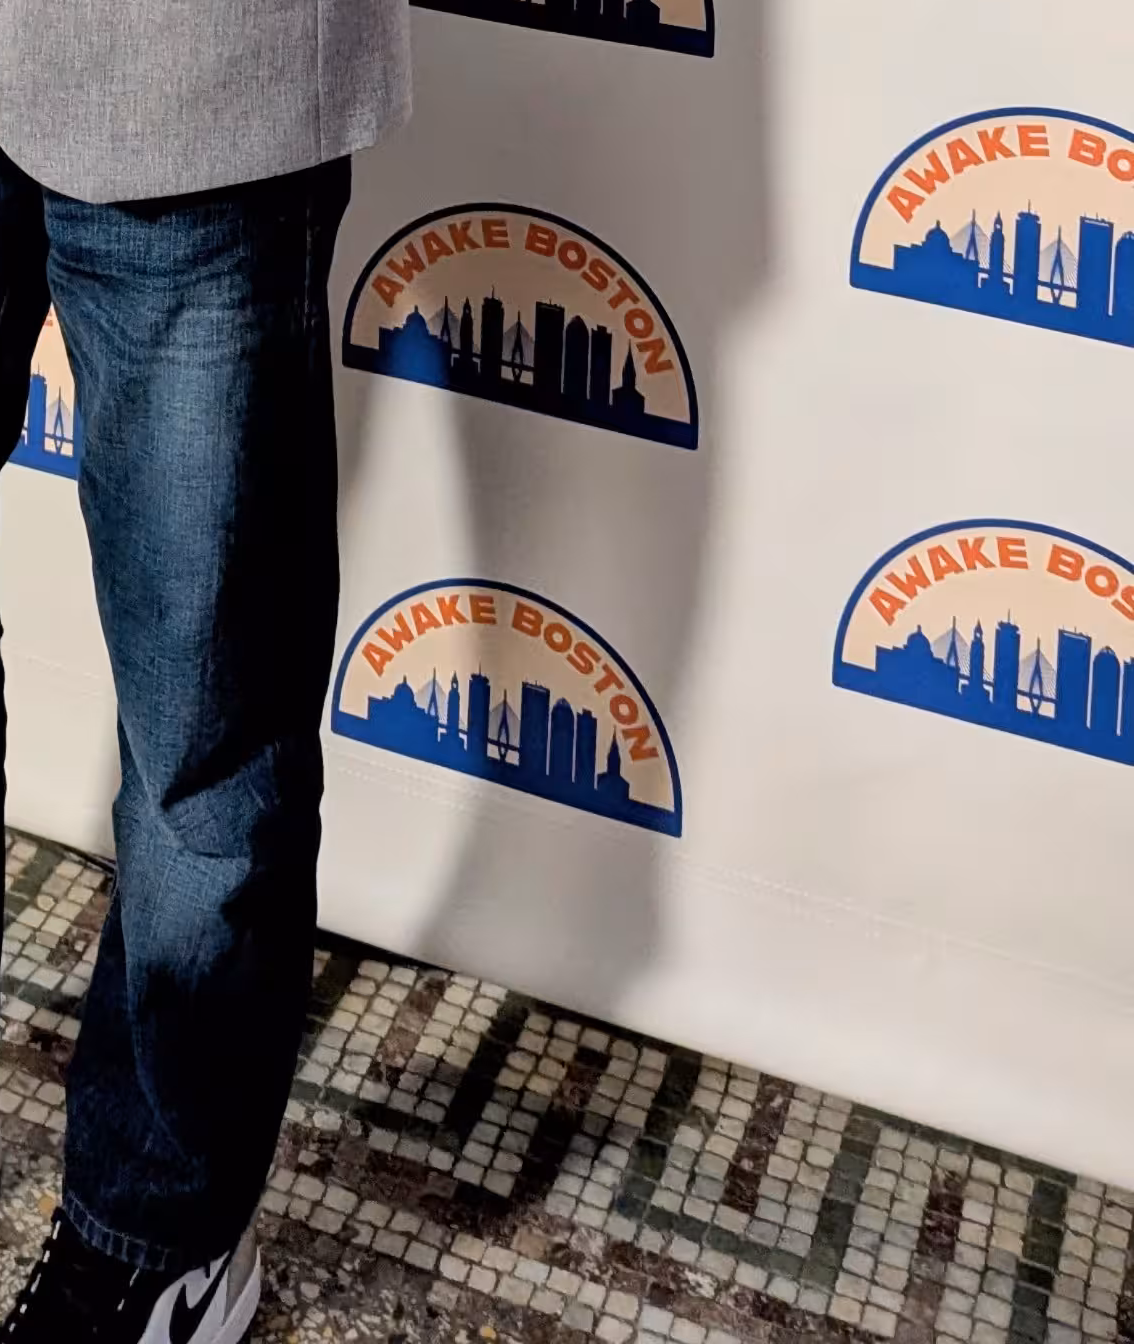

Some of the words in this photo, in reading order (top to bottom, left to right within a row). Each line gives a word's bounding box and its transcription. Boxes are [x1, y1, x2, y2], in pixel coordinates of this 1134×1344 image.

[886, 124, 1050, 224] AWAKE
[371, 216, 511, 308] AWAKE
[523, 224, 675, 378] BOSTON
[868, 535, 1030, 625] AWAKE
[1045, 543, 1134, 621] BOS
[361, 593, 498, 678] AWAKE
[510, 599, 659, 763] BOSTON
